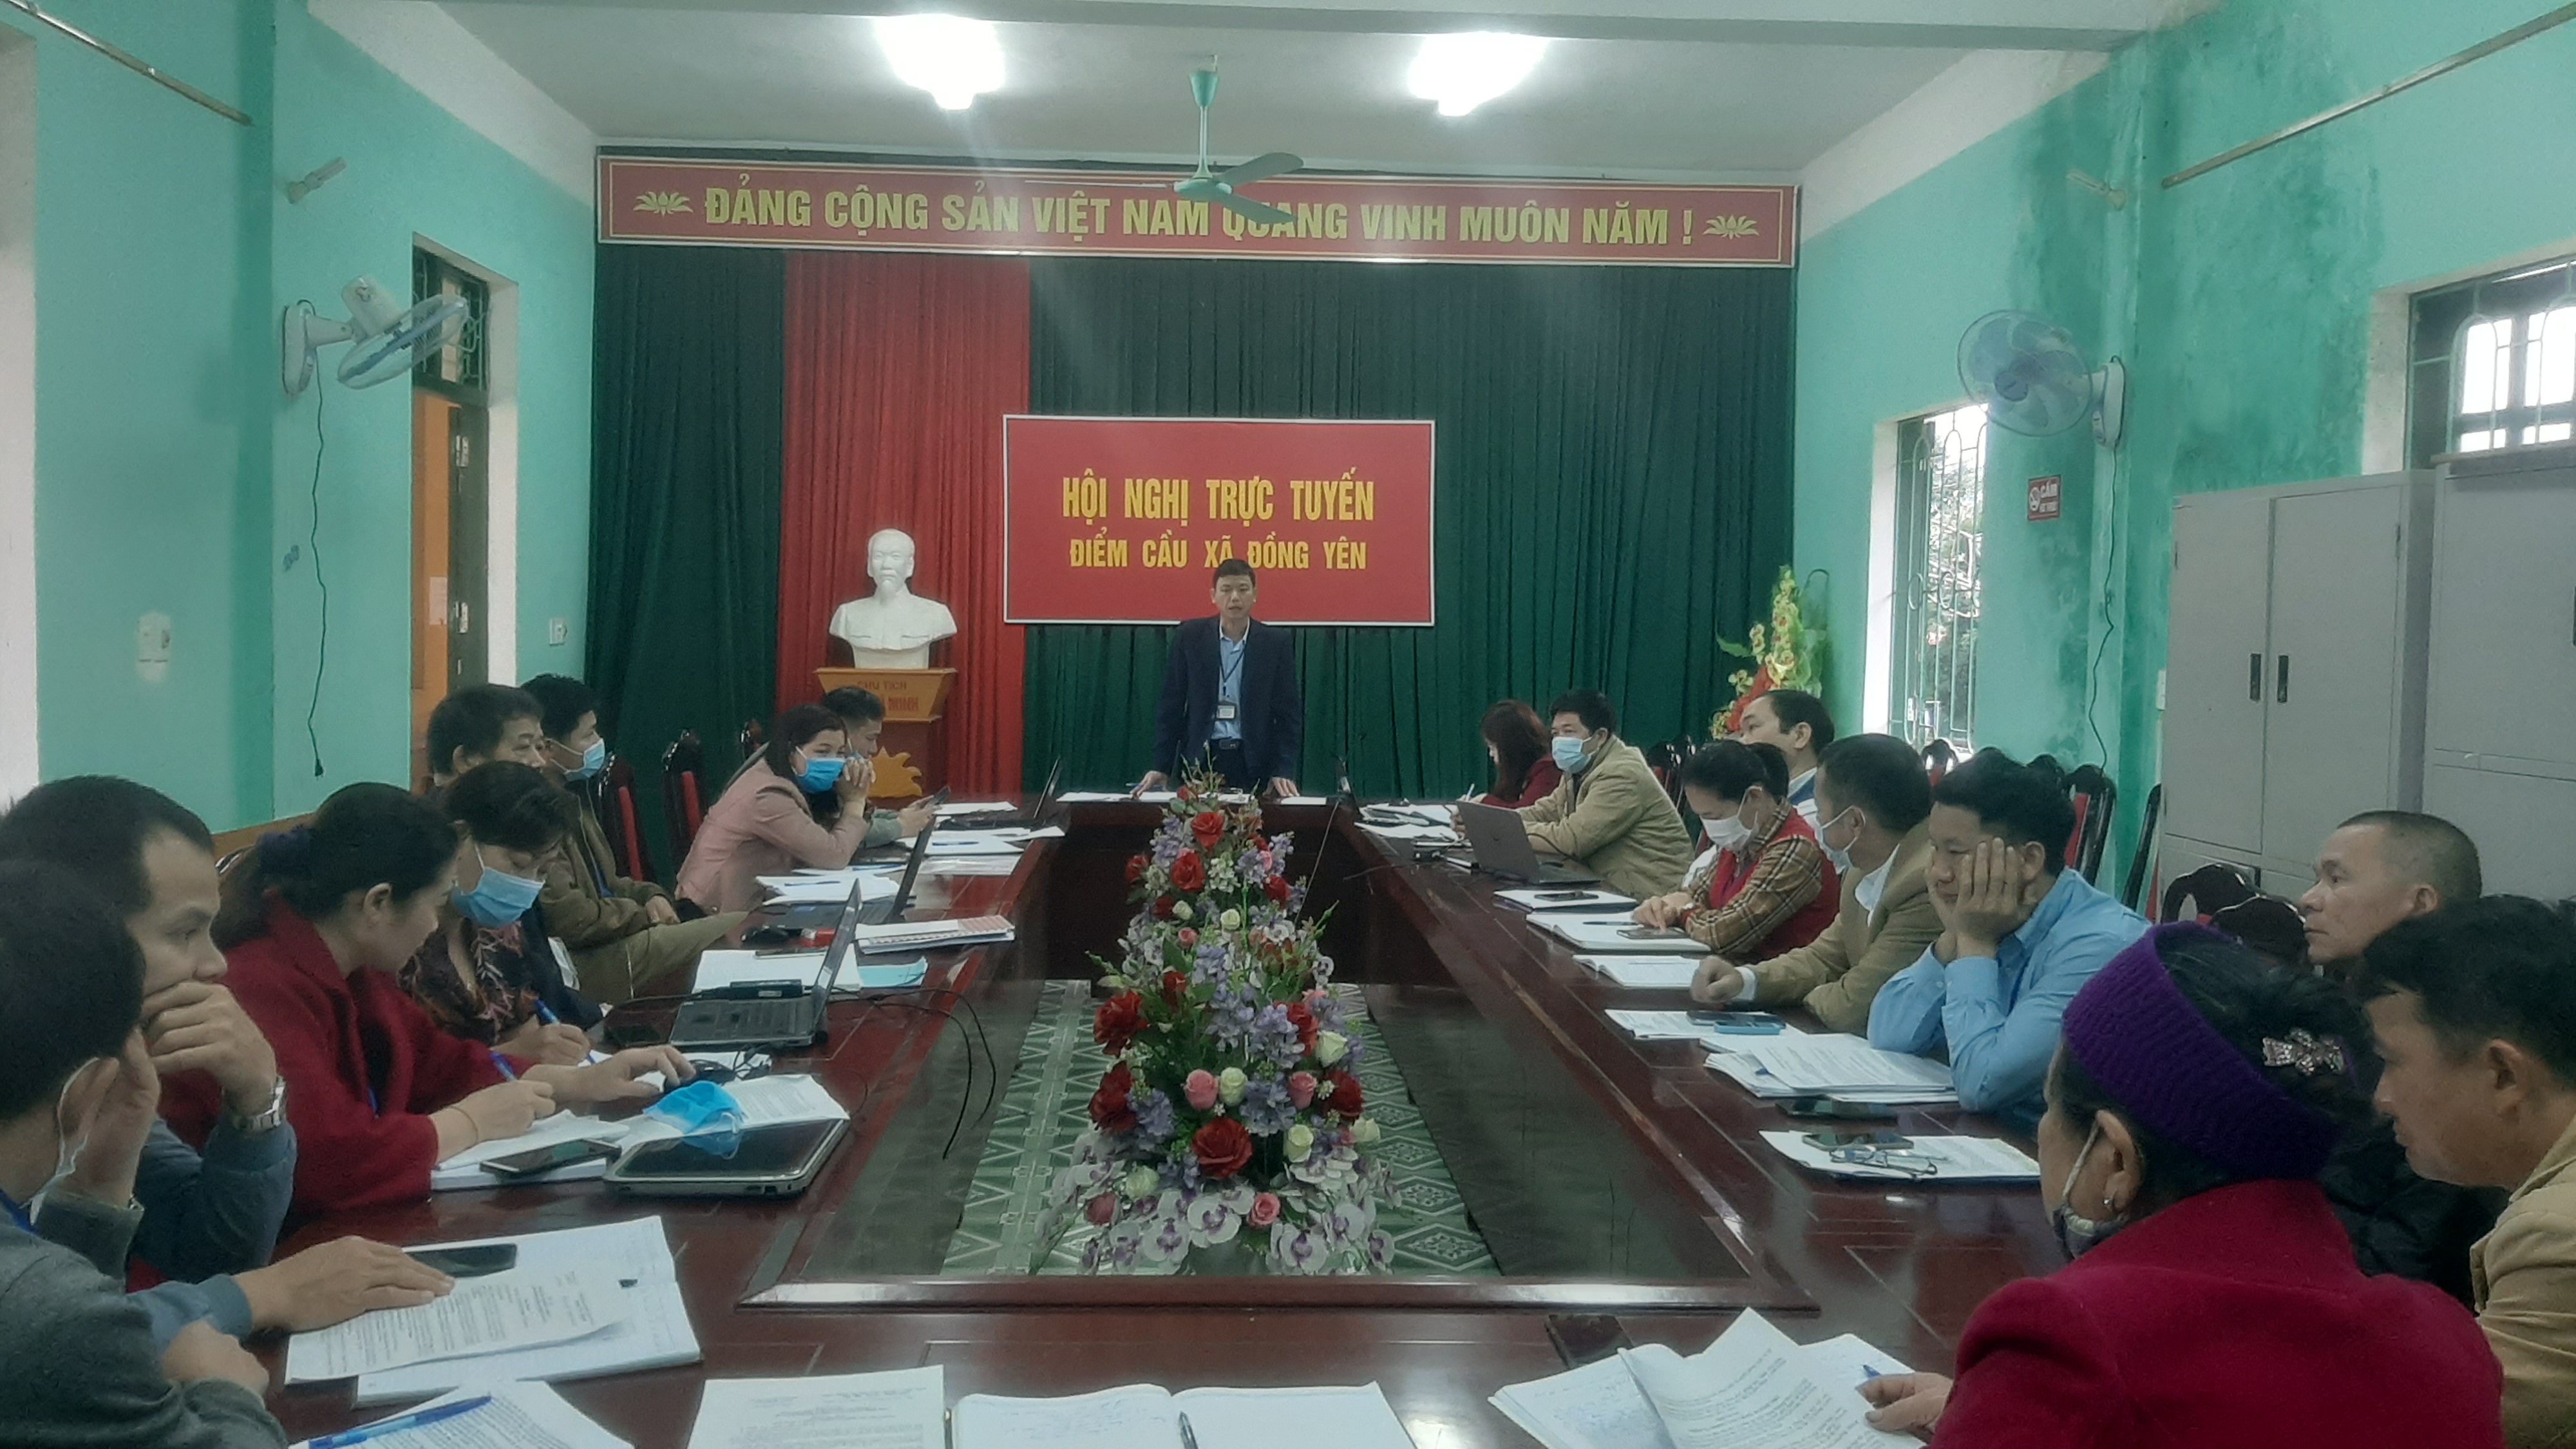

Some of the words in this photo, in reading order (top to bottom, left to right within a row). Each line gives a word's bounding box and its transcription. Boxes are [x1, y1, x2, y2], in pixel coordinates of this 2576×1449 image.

[705, 173, 811, 226] ĐẢNG
[825, 184, 929, 236] CỘNG
[941, 180, 1019, 233] SẢN
[1034, 189, 1111, 242] VIỆT
[1122, 198, 1209, 236] NAM
[1359, 203, 1448, 242] VINH
[1459, 200, 1571, 245] MUÔN
[1582, 200, 1669, 245] NĂM
[1063, 468, 1107, 525] HỘI
[1124, 478, 1189, 527] NGHỊ
[1206, 475, 1274, 527] TRỰC
[1289, 466, 1374, 521] TUYẾN
[1069, 526, 1128, 567] ĐIỂM
[1142, 529, 1188, 568] CẦU
[1204, 535, 1233, 568] XÃ
[1247, 531, 1309, 569] ĐỒNG
[1323, 536, 1367, 569] YÊN
